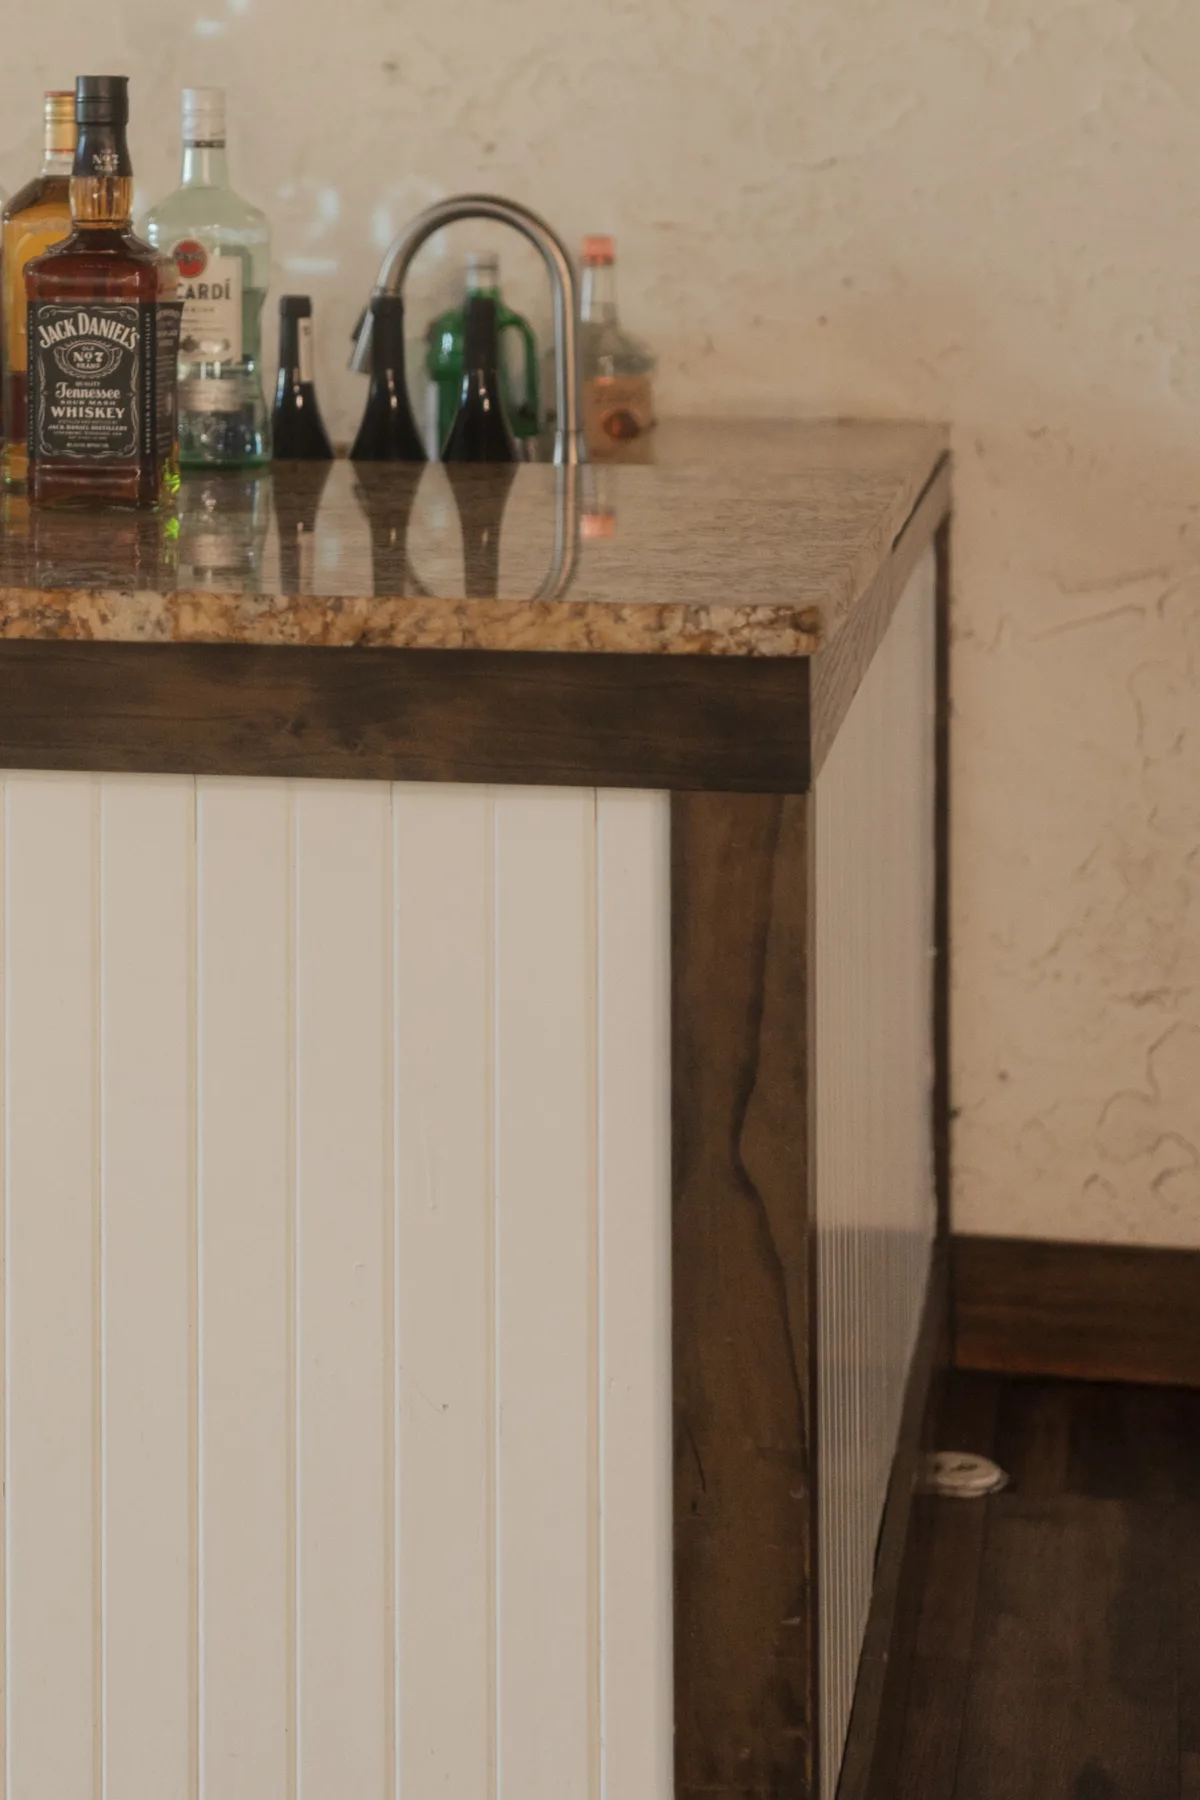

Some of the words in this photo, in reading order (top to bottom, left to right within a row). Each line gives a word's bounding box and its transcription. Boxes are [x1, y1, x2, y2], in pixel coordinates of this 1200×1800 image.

[177, 278, 232, 300] ARDÍ
[37, 314, 77, 349] JACK
[77, 312, 141, 352] DANIEL'S
[55, 381, 121, 399] Tennessee
[50, 406, 126, 420] WHISKEY
